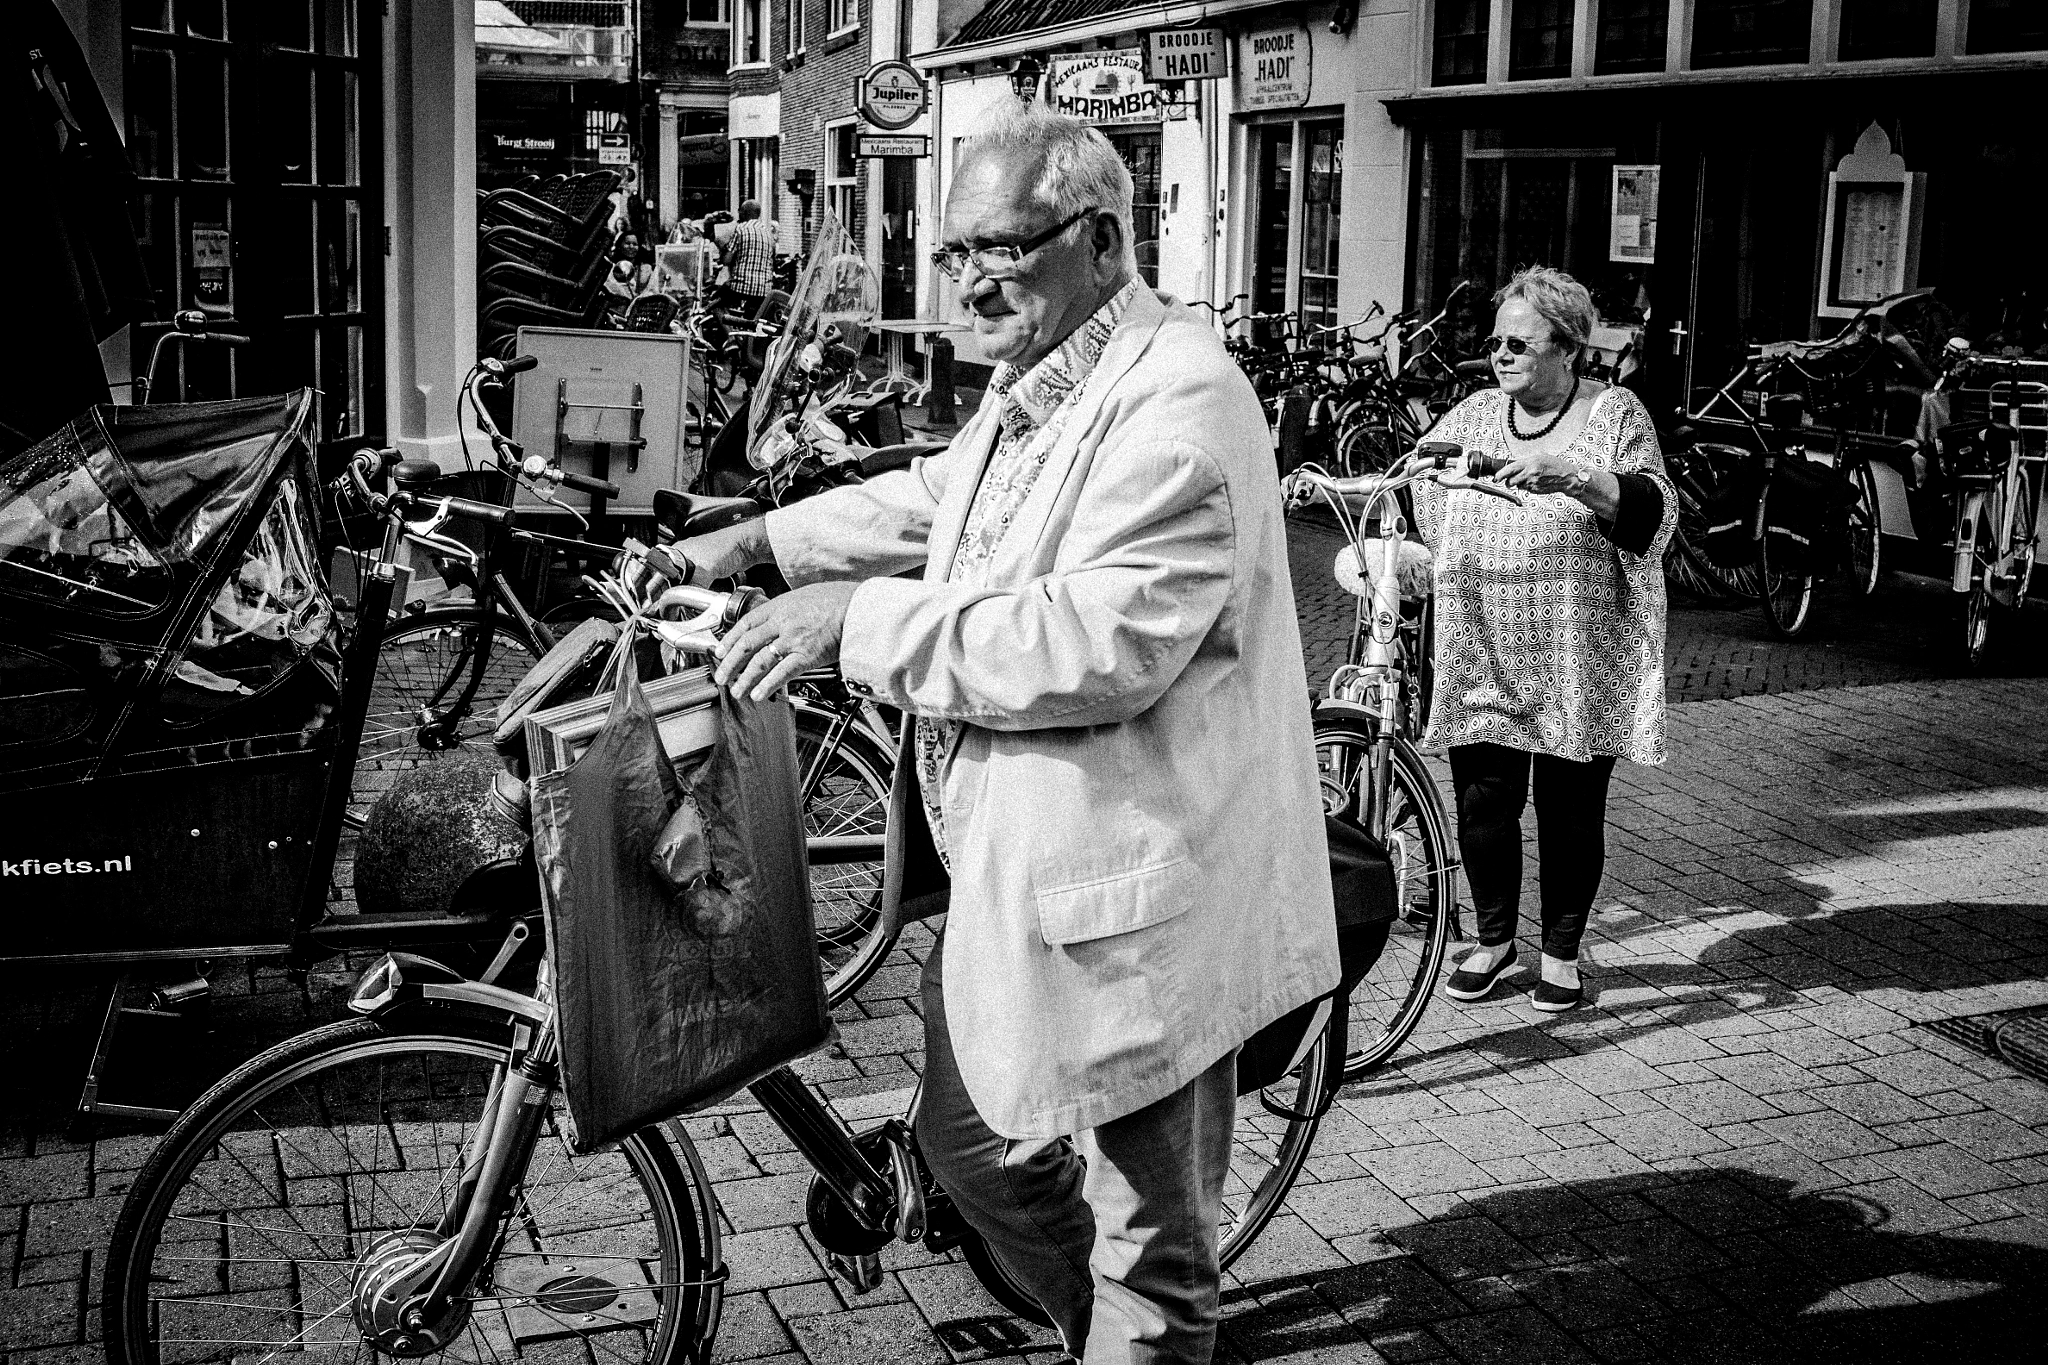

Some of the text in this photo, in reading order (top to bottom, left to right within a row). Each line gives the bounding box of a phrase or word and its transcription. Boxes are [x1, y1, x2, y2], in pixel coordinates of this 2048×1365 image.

[1159, 31, 1213, 48] BROODJE
[1254, 33, 1295, 55] BROODJE
[1055, 57, 1099, 88] MEXICAANS
[873, 87, 919, 101] Jupiler
[1057, 90, 1158, 119] MARIMBA
[870, 145, 914, 155] Marimba
[2, 855, 132, 876] kfiets.nl
